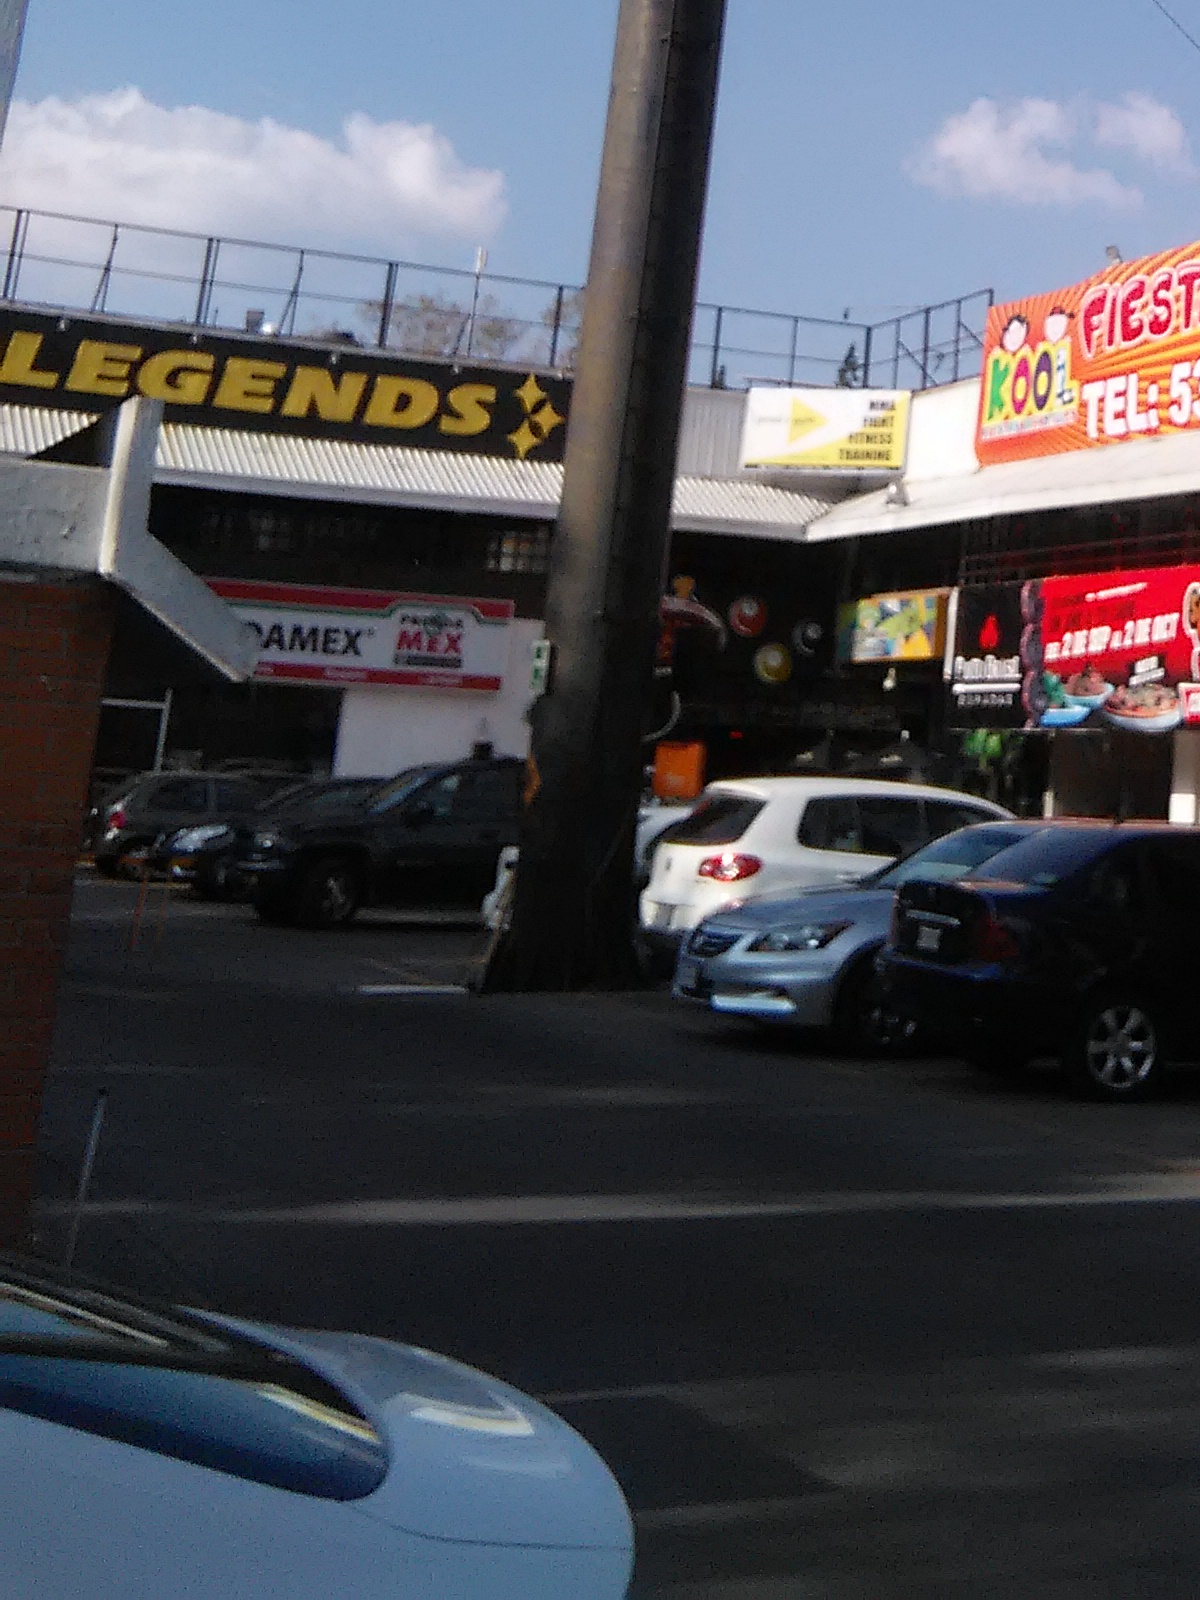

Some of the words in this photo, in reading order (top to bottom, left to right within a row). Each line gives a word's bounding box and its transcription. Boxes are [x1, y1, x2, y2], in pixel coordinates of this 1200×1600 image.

[0, 330, 497, 437] LEGENDS
[987, 346, 1075, 421] KOOL
[1082, 370, 1159, 440] TEL:
[396, 631, 462, 654] MEX
